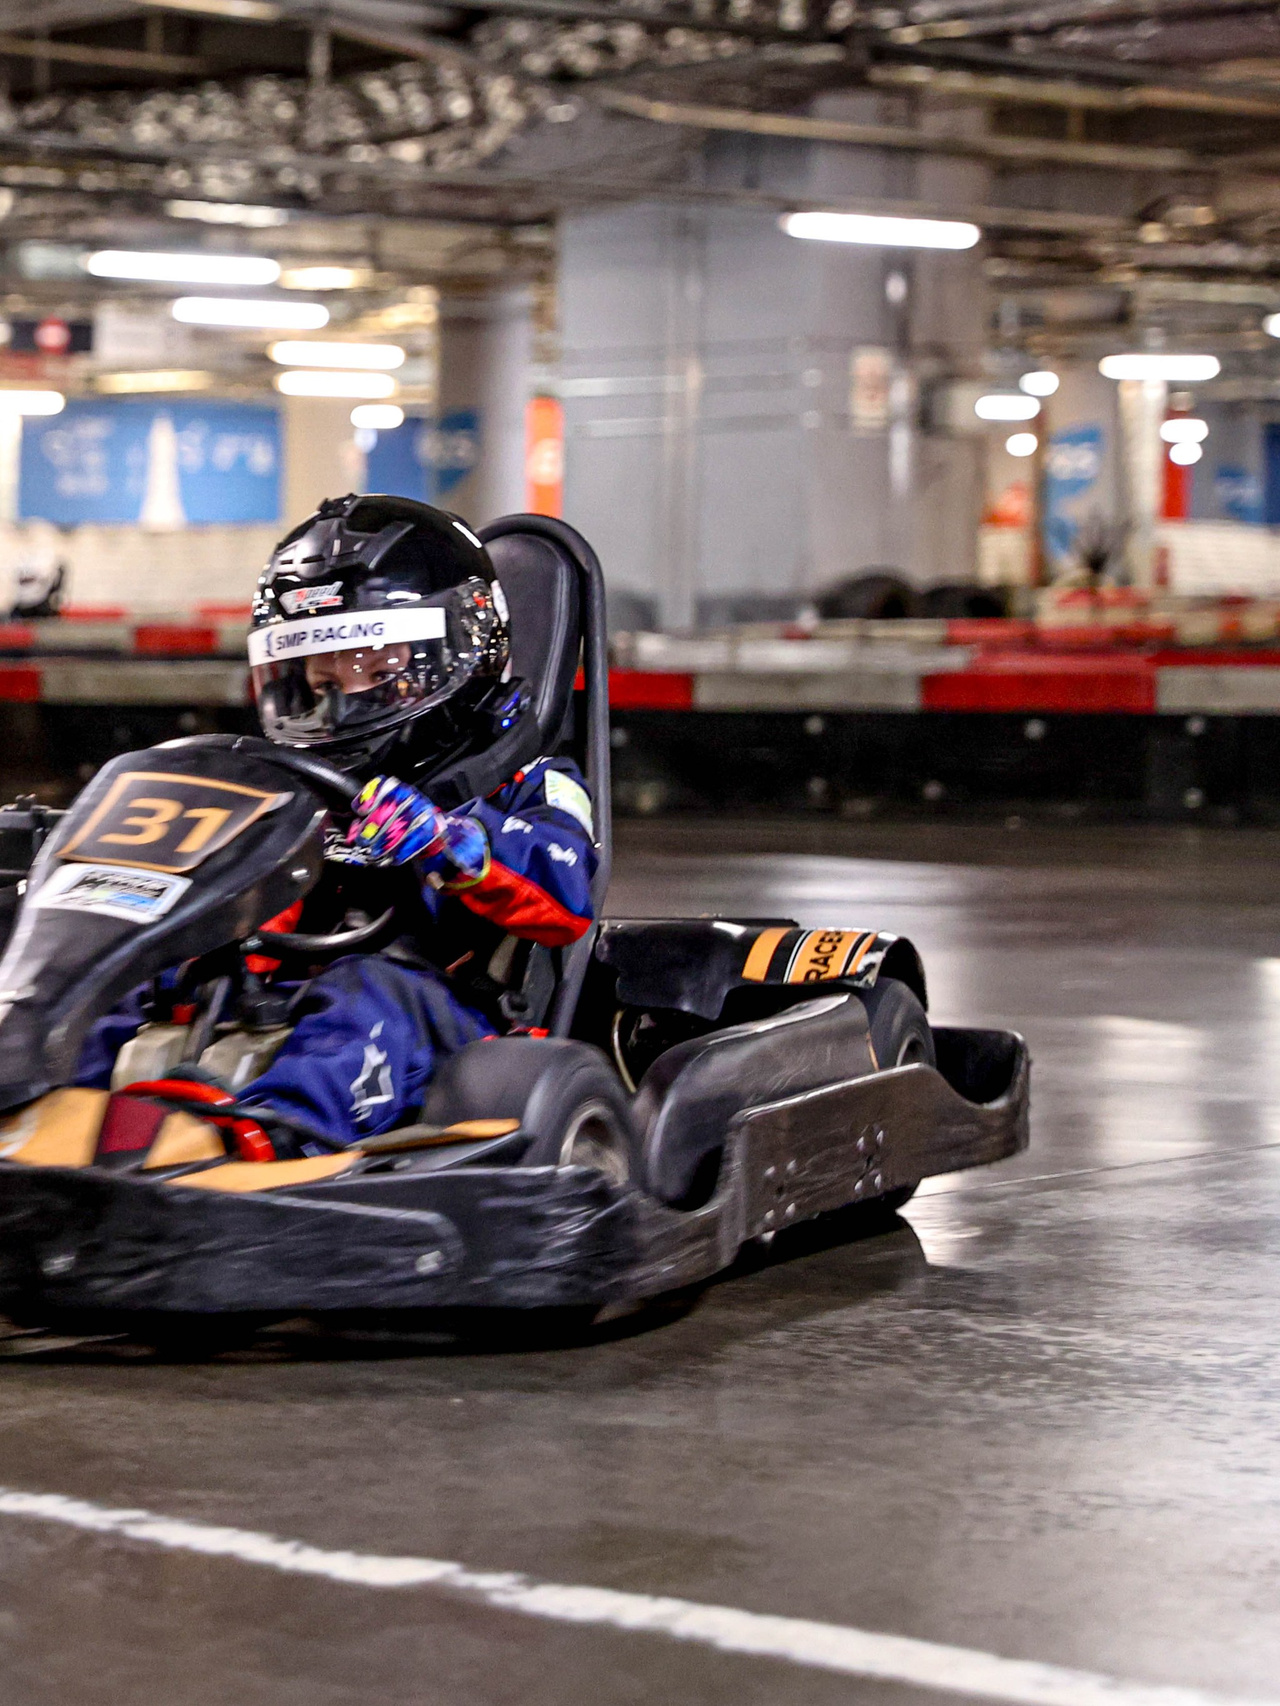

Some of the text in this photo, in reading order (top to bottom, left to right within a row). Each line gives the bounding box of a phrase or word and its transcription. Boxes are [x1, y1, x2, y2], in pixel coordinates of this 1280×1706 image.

[276, 622, 384, 650] SMP RACING
[98, 798, 233, 853] 31
